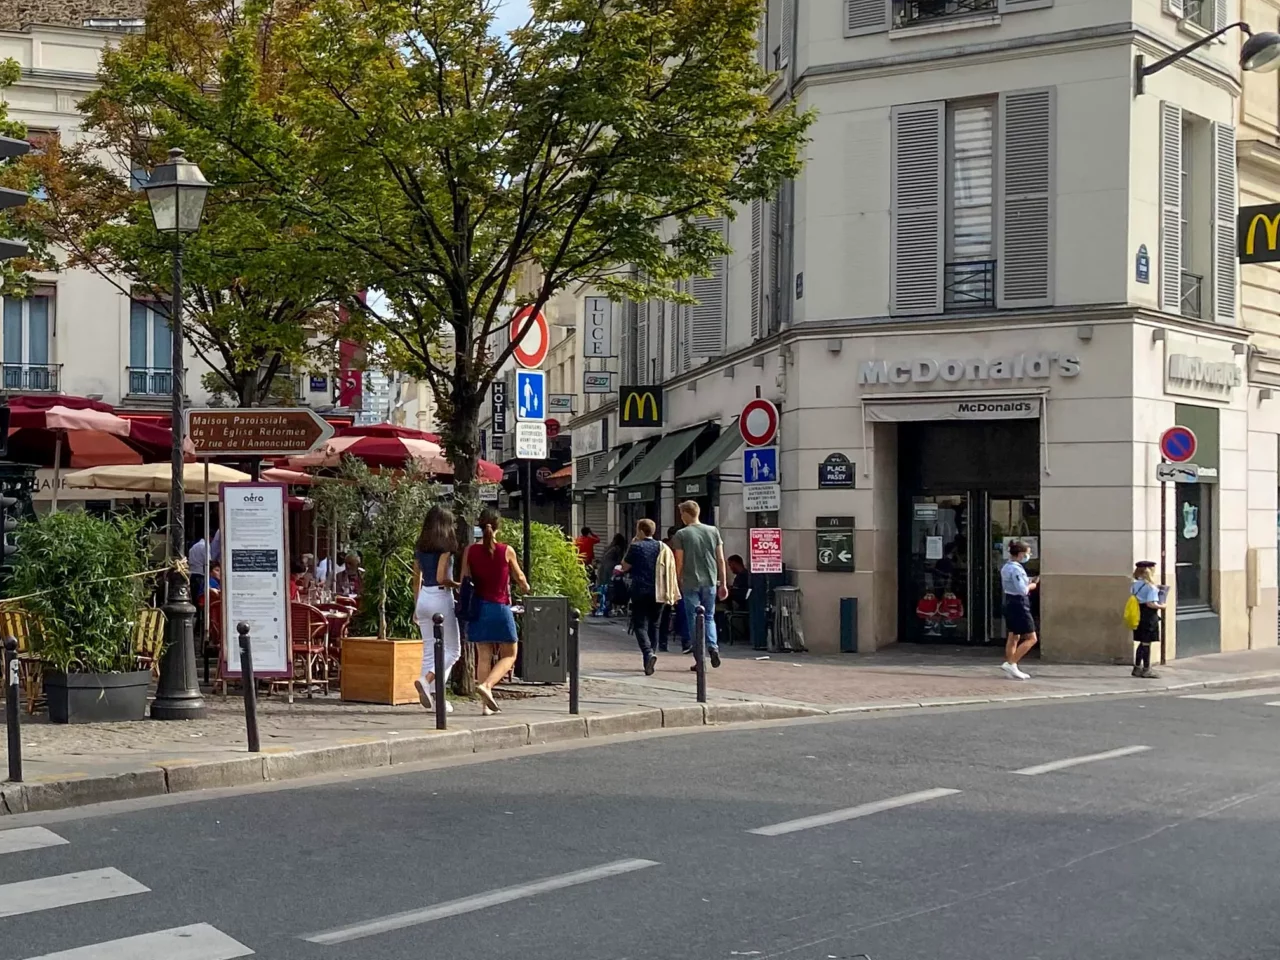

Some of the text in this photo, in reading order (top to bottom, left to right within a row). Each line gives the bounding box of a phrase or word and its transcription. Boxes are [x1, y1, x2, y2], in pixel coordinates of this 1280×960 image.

[592, 298, 604, 355] LUCE
[857, 349, 1082, 385] McDonald's
[493, 383, 504, 432] HOTEL
[958, 401, 1031, 413] McDonald's
[192, 415, 287, 425] Maison Paroissiale
[193, 428, 204, 436] de
[223, 427, 253, 437] Église
[194, 439, 205, 447] 27
[208, 439, 223, 447] rue
[227, 439, 238, 447] de
[243, 492, 264, 502] aéro
[753, 541, 779, 550] -50%
